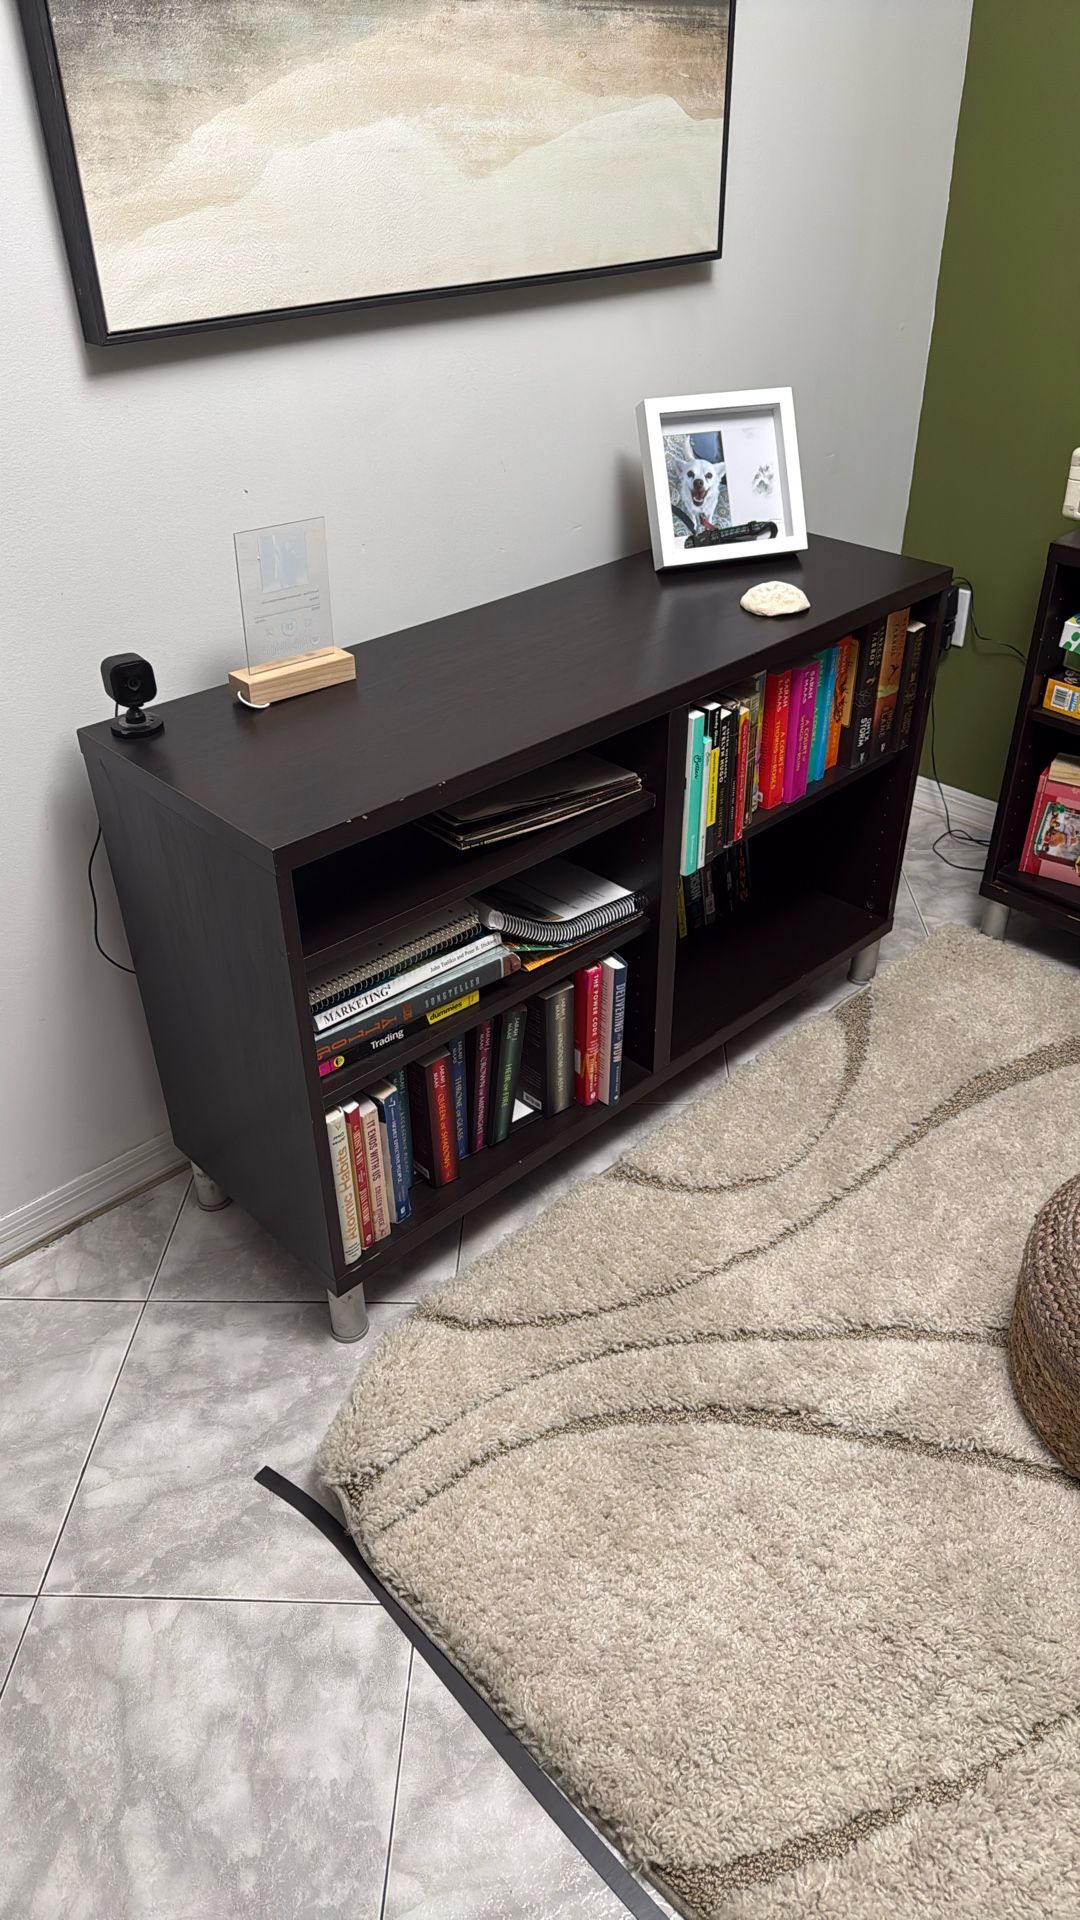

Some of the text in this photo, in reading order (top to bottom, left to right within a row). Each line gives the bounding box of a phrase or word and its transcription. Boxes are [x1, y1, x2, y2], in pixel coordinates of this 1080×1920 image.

[869, 632, 879, 666] YARROS
[783, 678, 791, 708] SARAH
[808, 670, 816, 699] SARAH
[773, 721, 781, 754] THORNS
[857, 717, 867, 747] STORM
[864, 717, 872, 742] ONYX
[778, 739, 786, 766] COURT
[430, 964, 441, 972] John
[457, 952, 465, 960] and
[464, 947, 475, 956] Peter
[424, 976, 480, 1009] SONGTELLER
[430, 1001, 463, 1020] dummies
[614, 983, 626, 1033] DELIVERING
[370, 1029, 404, 1050] Trading
[612, 1040, 623, 1063] WOW
[479, 1056, 488, 1088] CROWN
[504, 1063, 513, 1081] HEIR
[388, 1097, 396, 1107] 7
[437, 1093, 446, 1121] QUEEN
[455, 1077, 463, 1109] THRONE
[502, 1091, 510, 1108] FIRE
[456, 1117, 464, 1141] GLASS
[477, 1096, 485, 1135] MIDNIGHT
[366, 1120, 382, 1182] IT ENDS WITH US
[393, 1138, 401, 1164] EFFECTIVE
[441, 1130, 450, 1169] SHADOWS
[336, 1146, 358, 1241] Atomic Habits
